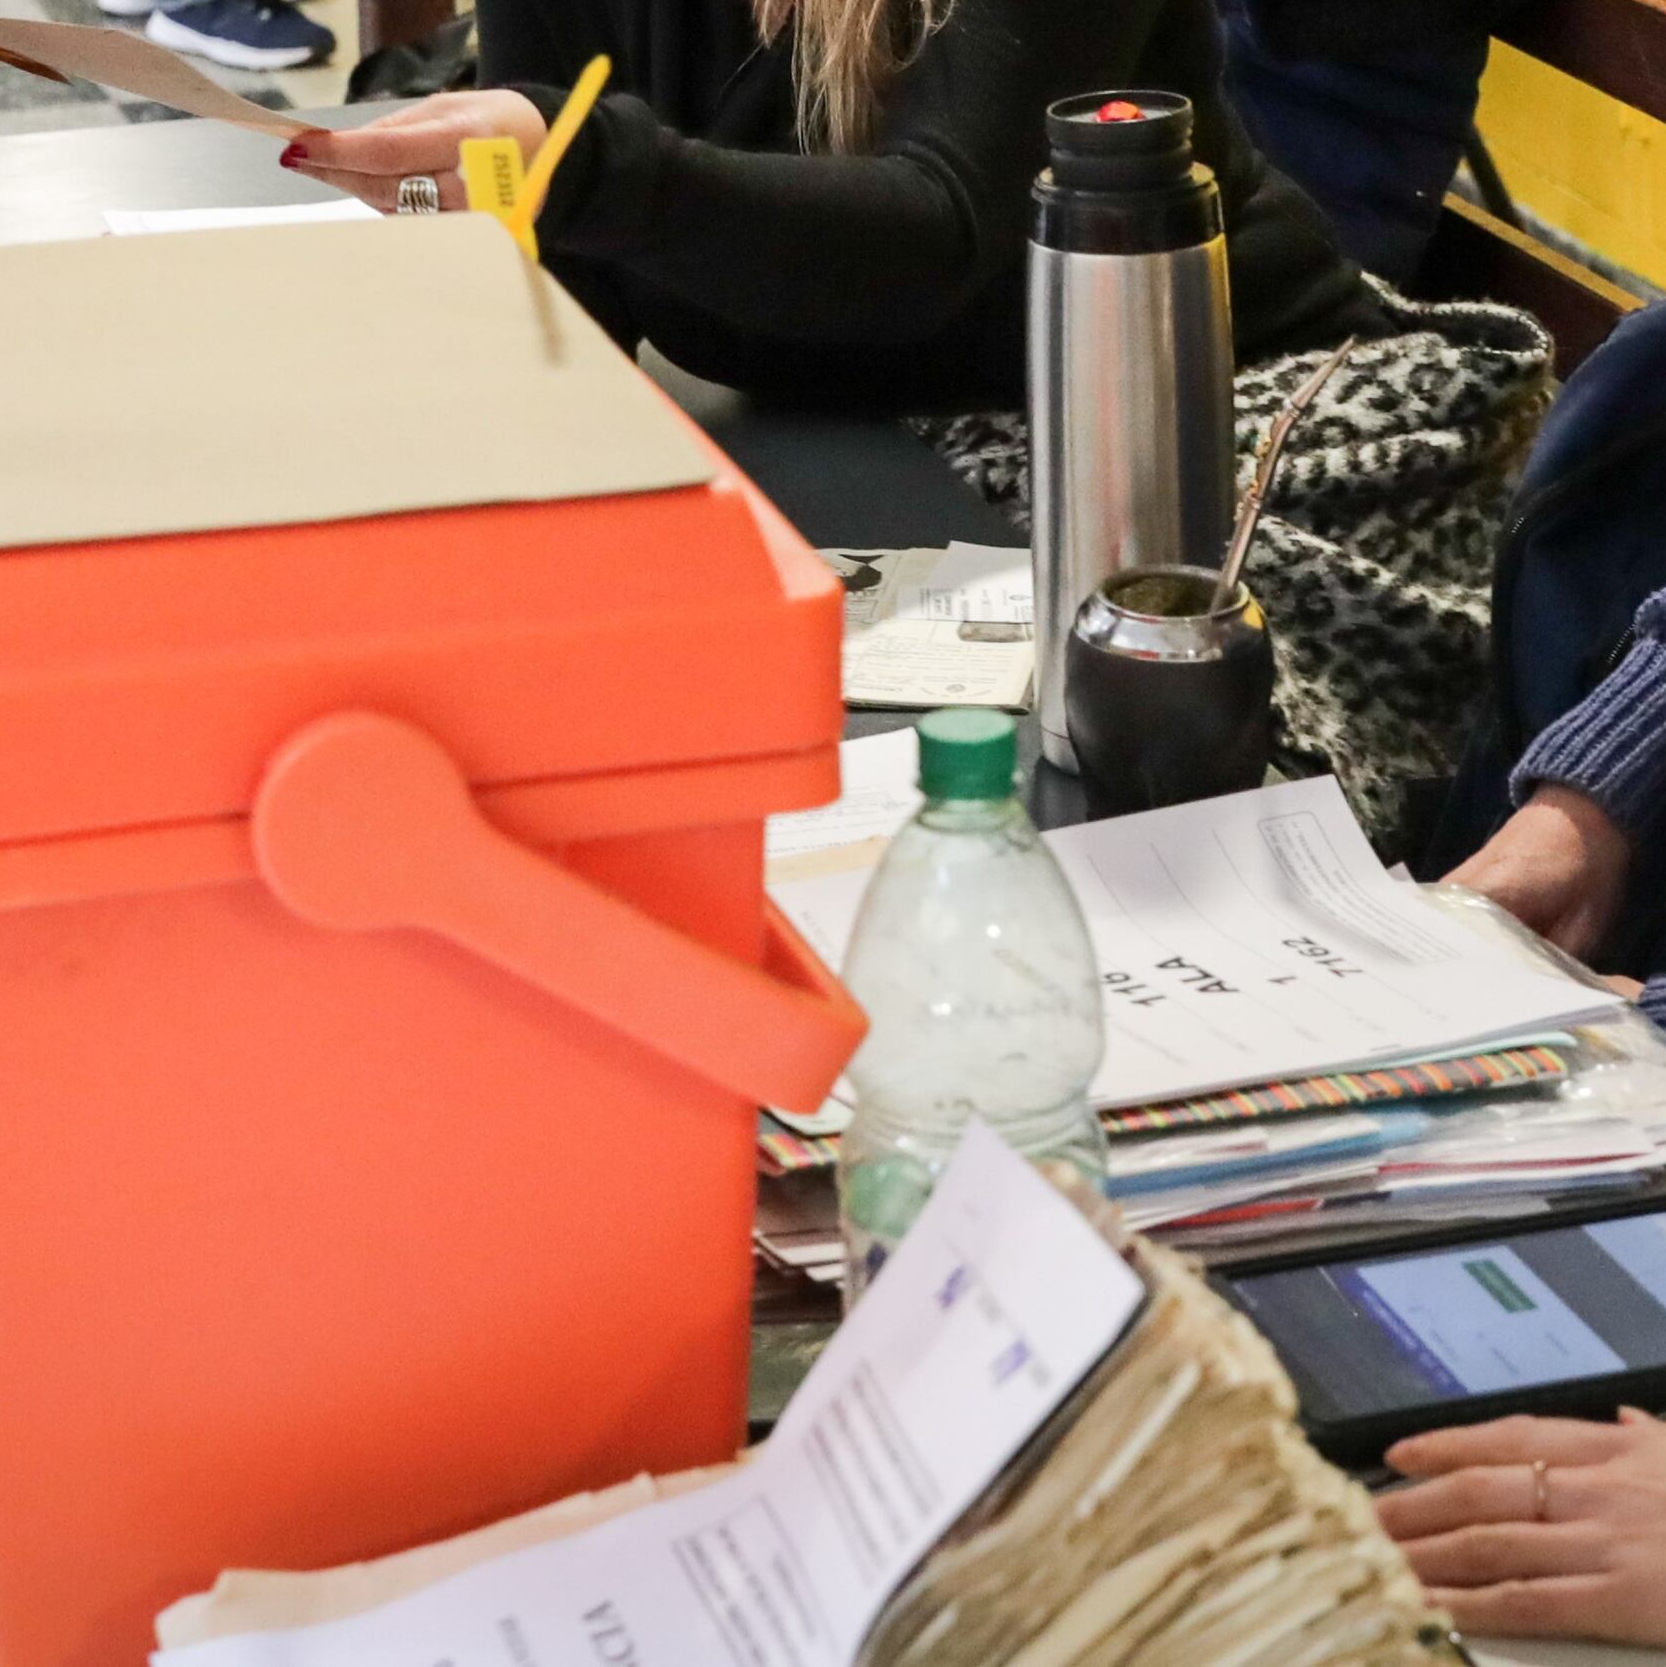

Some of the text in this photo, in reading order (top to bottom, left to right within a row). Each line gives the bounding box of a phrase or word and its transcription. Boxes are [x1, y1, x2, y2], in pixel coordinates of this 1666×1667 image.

[1154, 956, 1240, 994] ALA
[1282, 936, 1364, 978] 7162
[1267, 975, 1297, 986] 1
